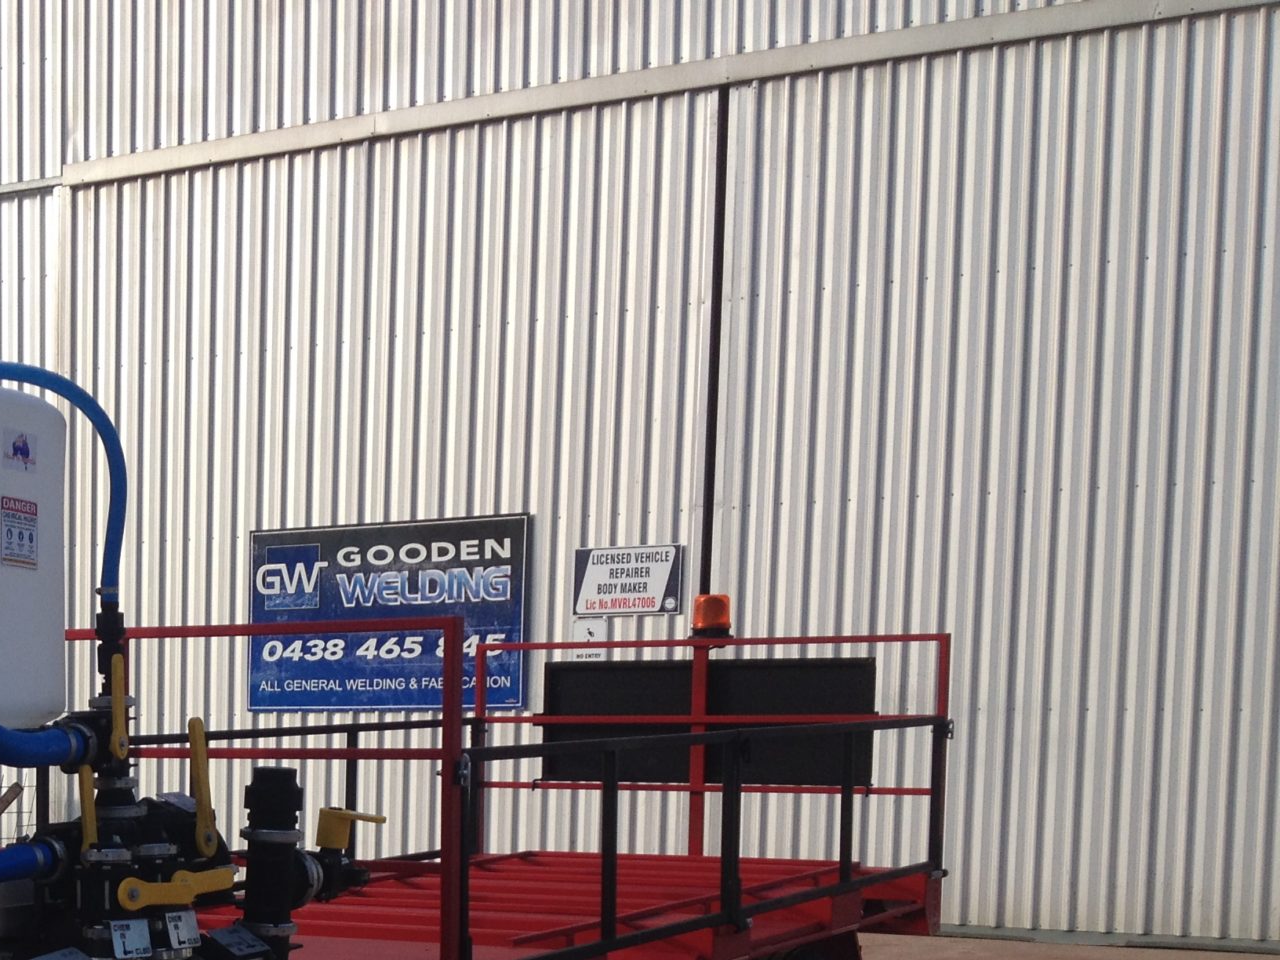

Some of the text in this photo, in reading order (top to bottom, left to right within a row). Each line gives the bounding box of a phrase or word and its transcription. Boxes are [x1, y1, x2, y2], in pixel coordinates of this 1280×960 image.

[3, 498, 36, 514] DANGER
[336, 538, 511, 567] GOODEN
[592, 551, 670, 565] LICENSED VEHICLE
[256, 561, 328, 595] GW
[609, 567, 650, 579] REPAIRER
[336, 565, 511, 607] WELDING
[597, 582, 648, 595] BODY MAKER
[586, 600, 596, 610] Lic
[262, 639, 345, 661] 0438
[356, 636, 423, 659] 465
[259, 680, 282, 692] ALL
[284, 679, 342, 691] GENERAL
[345, 678, 406, 690] WELDING
[409, 677, 418, 689] &
